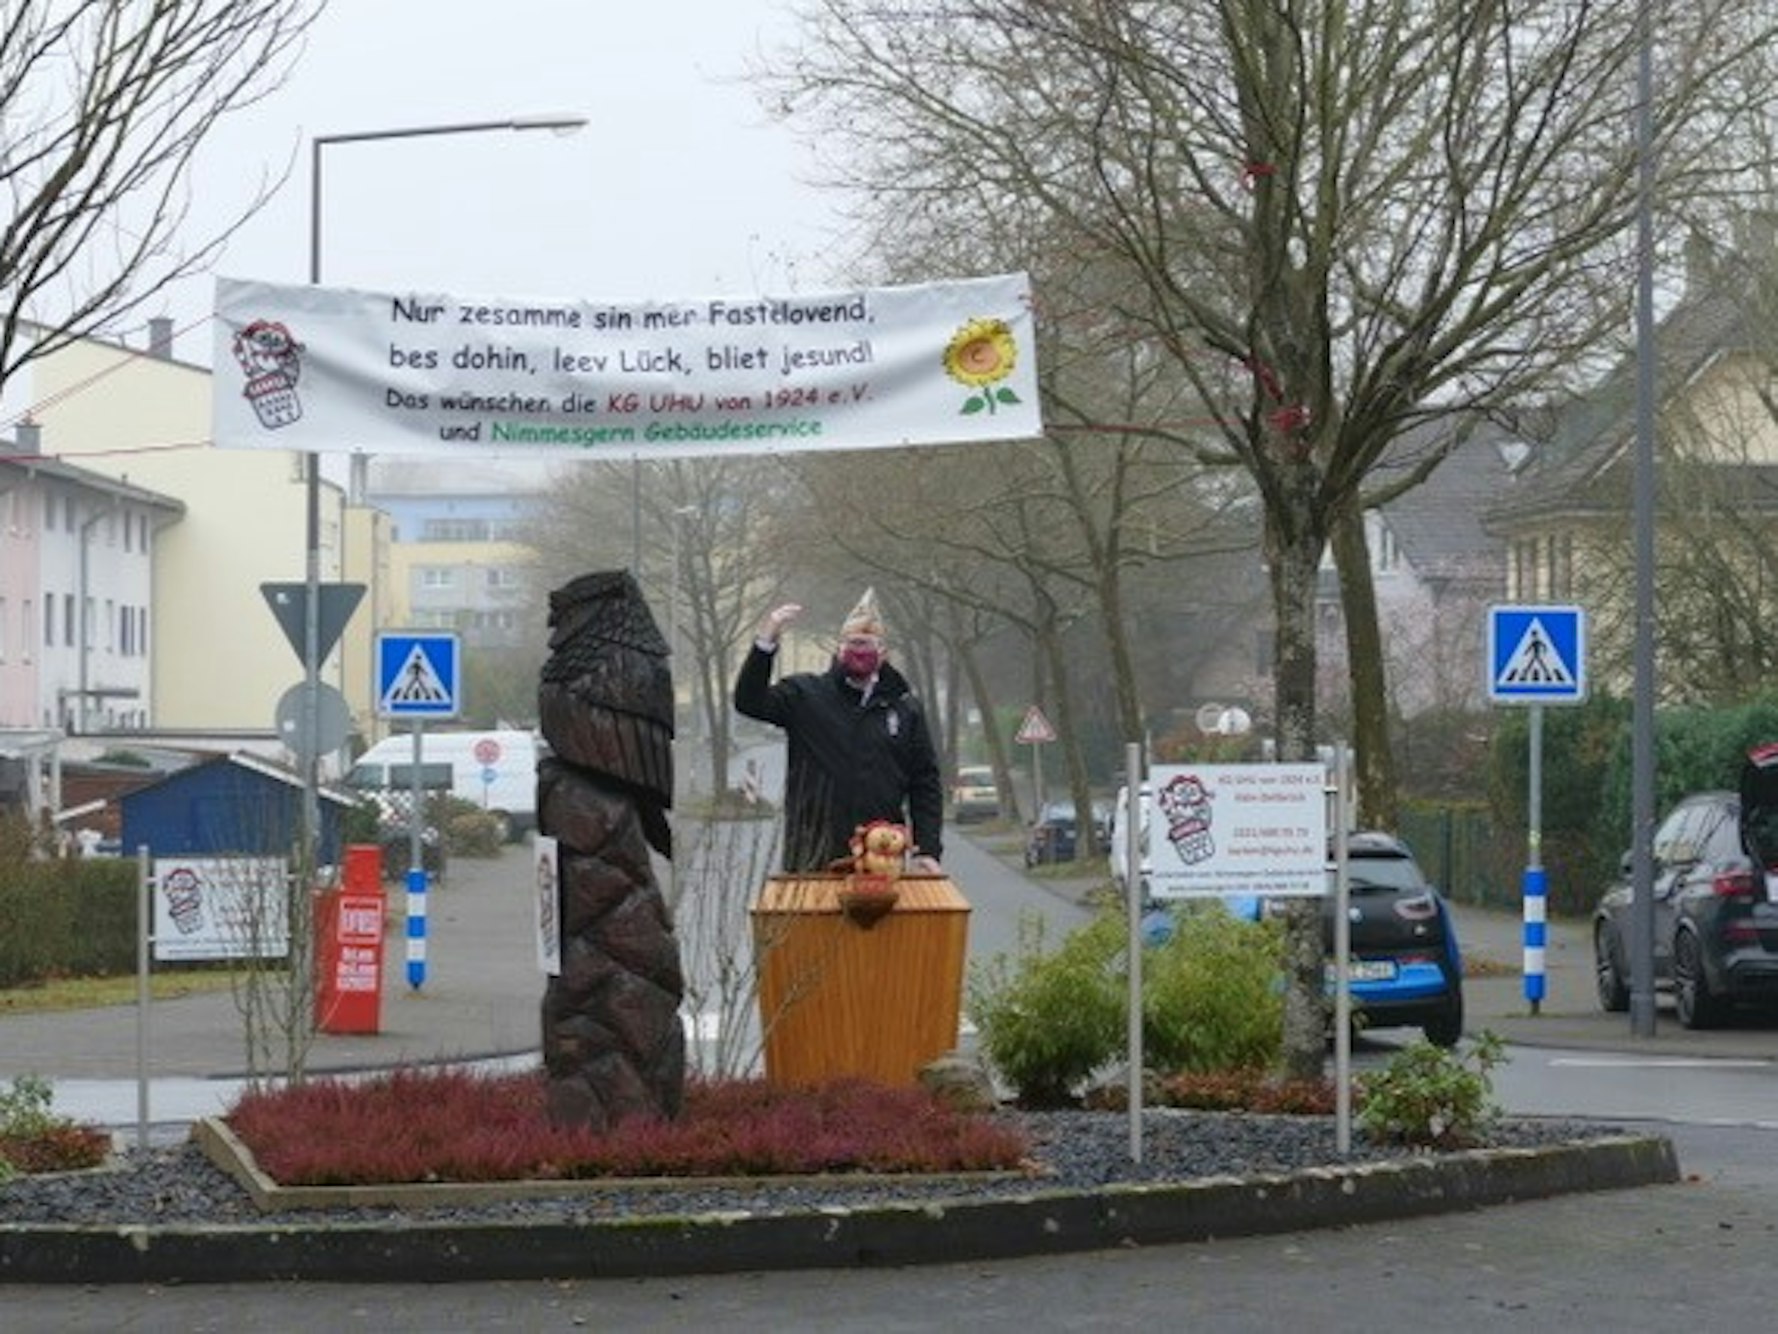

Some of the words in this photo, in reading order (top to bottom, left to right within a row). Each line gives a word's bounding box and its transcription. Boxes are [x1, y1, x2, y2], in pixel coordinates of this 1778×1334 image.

[392, 297, 446, 323] Nur
[458, 304, 582, 330] zesamme
[594, 305, 632, 330] sin
[643, 308, 697, 330] mer
[390, 343, 438, 369] bes
[453, 344, 537, 375] dohin,
[554, 347, 608, 372] leev
[620, 345, 692, 375] Lück,
[708, 346, 768, 371] bliet
[781, 340, 874, 375] jesund!
[387, 387, 429, 410] Das
[441, 391, 550, 413] wünschen
[562, 392, 597, 413] die
[608, 392, 638, 413] KG
[650, 392, 704, 413] UHU
[715, 395, 751, 411] von
[764, 386, 817, 409] 1924
[440, 421, 481, 442] und
[492, 421, 635, 447] Nimmesgern
